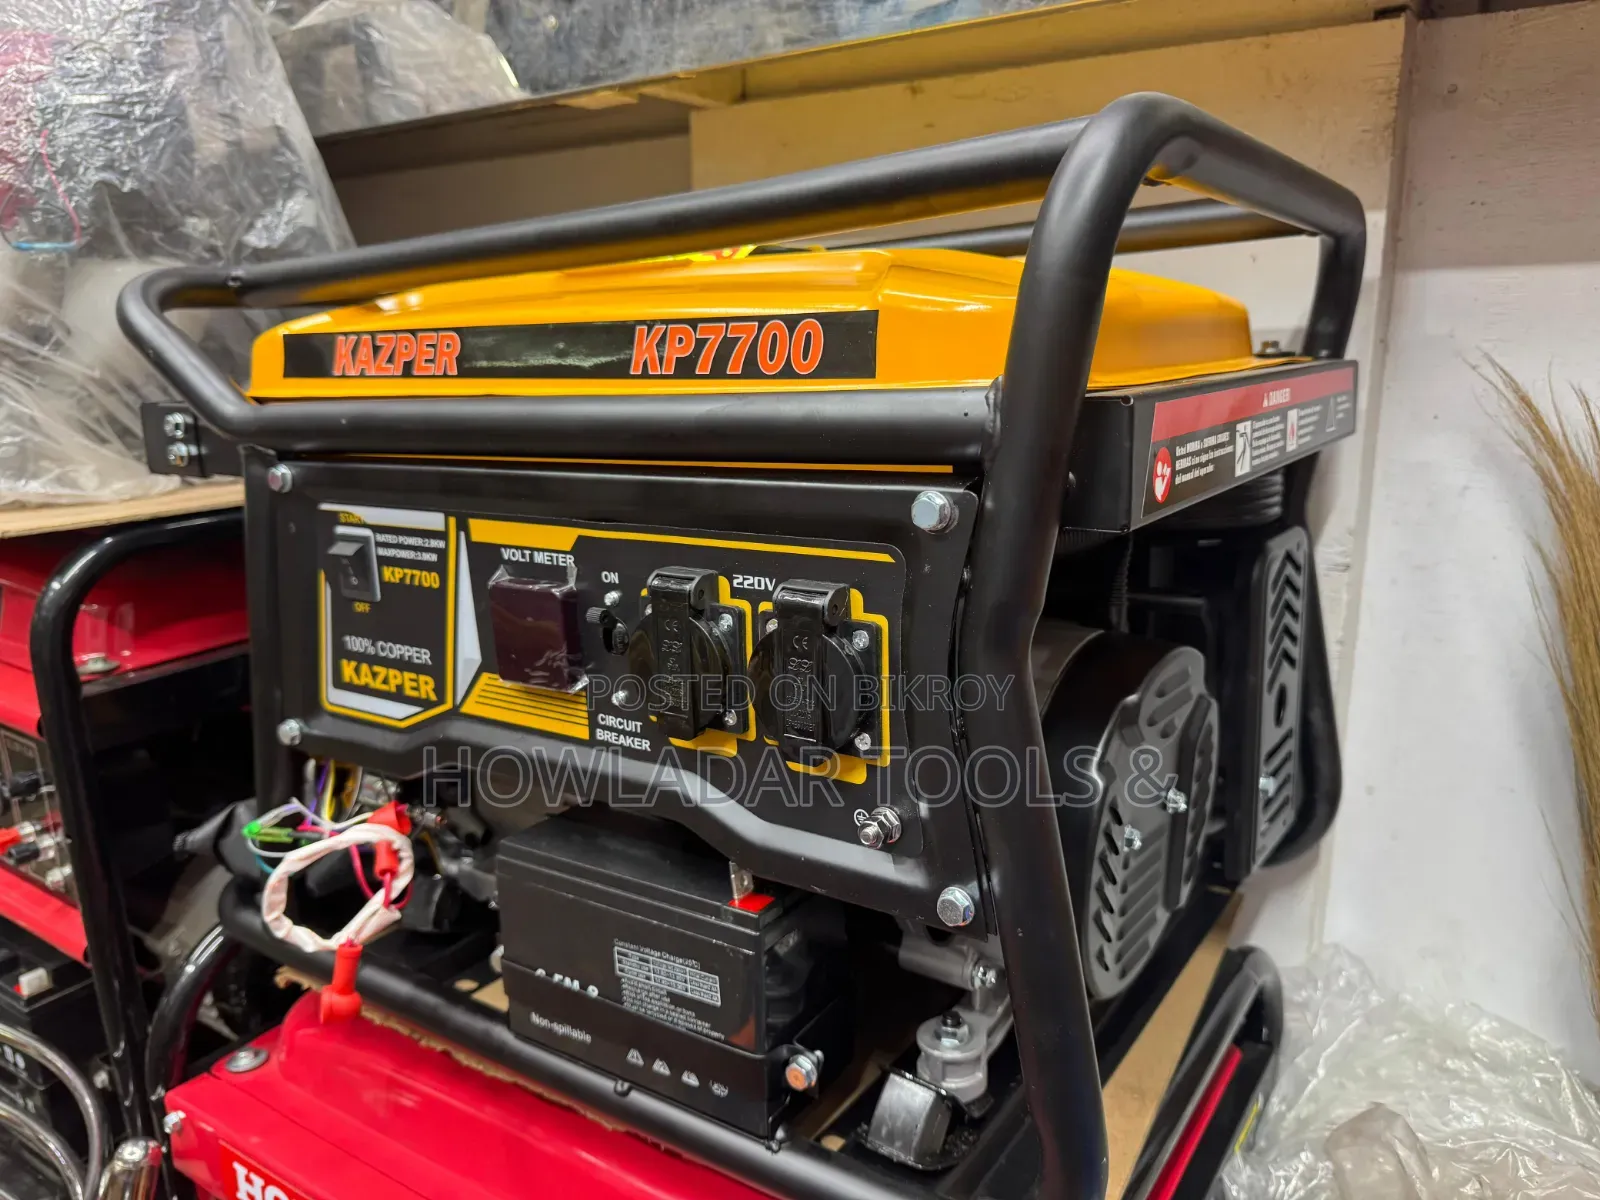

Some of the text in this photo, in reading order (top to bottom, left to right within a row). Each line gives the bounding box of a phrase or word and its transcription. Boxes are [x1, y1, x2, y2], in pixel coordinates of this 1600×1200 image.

[332, 318, 824, 376] KAZPER KP7700
[375, 532, 398, 544] RATED
[501, 547, 576, 568] VOLT METER
[382, 565, 440, 589] KP7700
[601, 570, 619, 584] ON
[732, 574, 777, 592] 220V
[354, 602, 371, 613] OFF
[343, 635, 433, 666] 100% COPPER
[341, 658, 438, 702] KAZPER
[597, 713, 643, 733] CIRCUIT
[595, 729, 652, 752] BREAKER
[529, 1010, 593, 1046] Non-spillable
